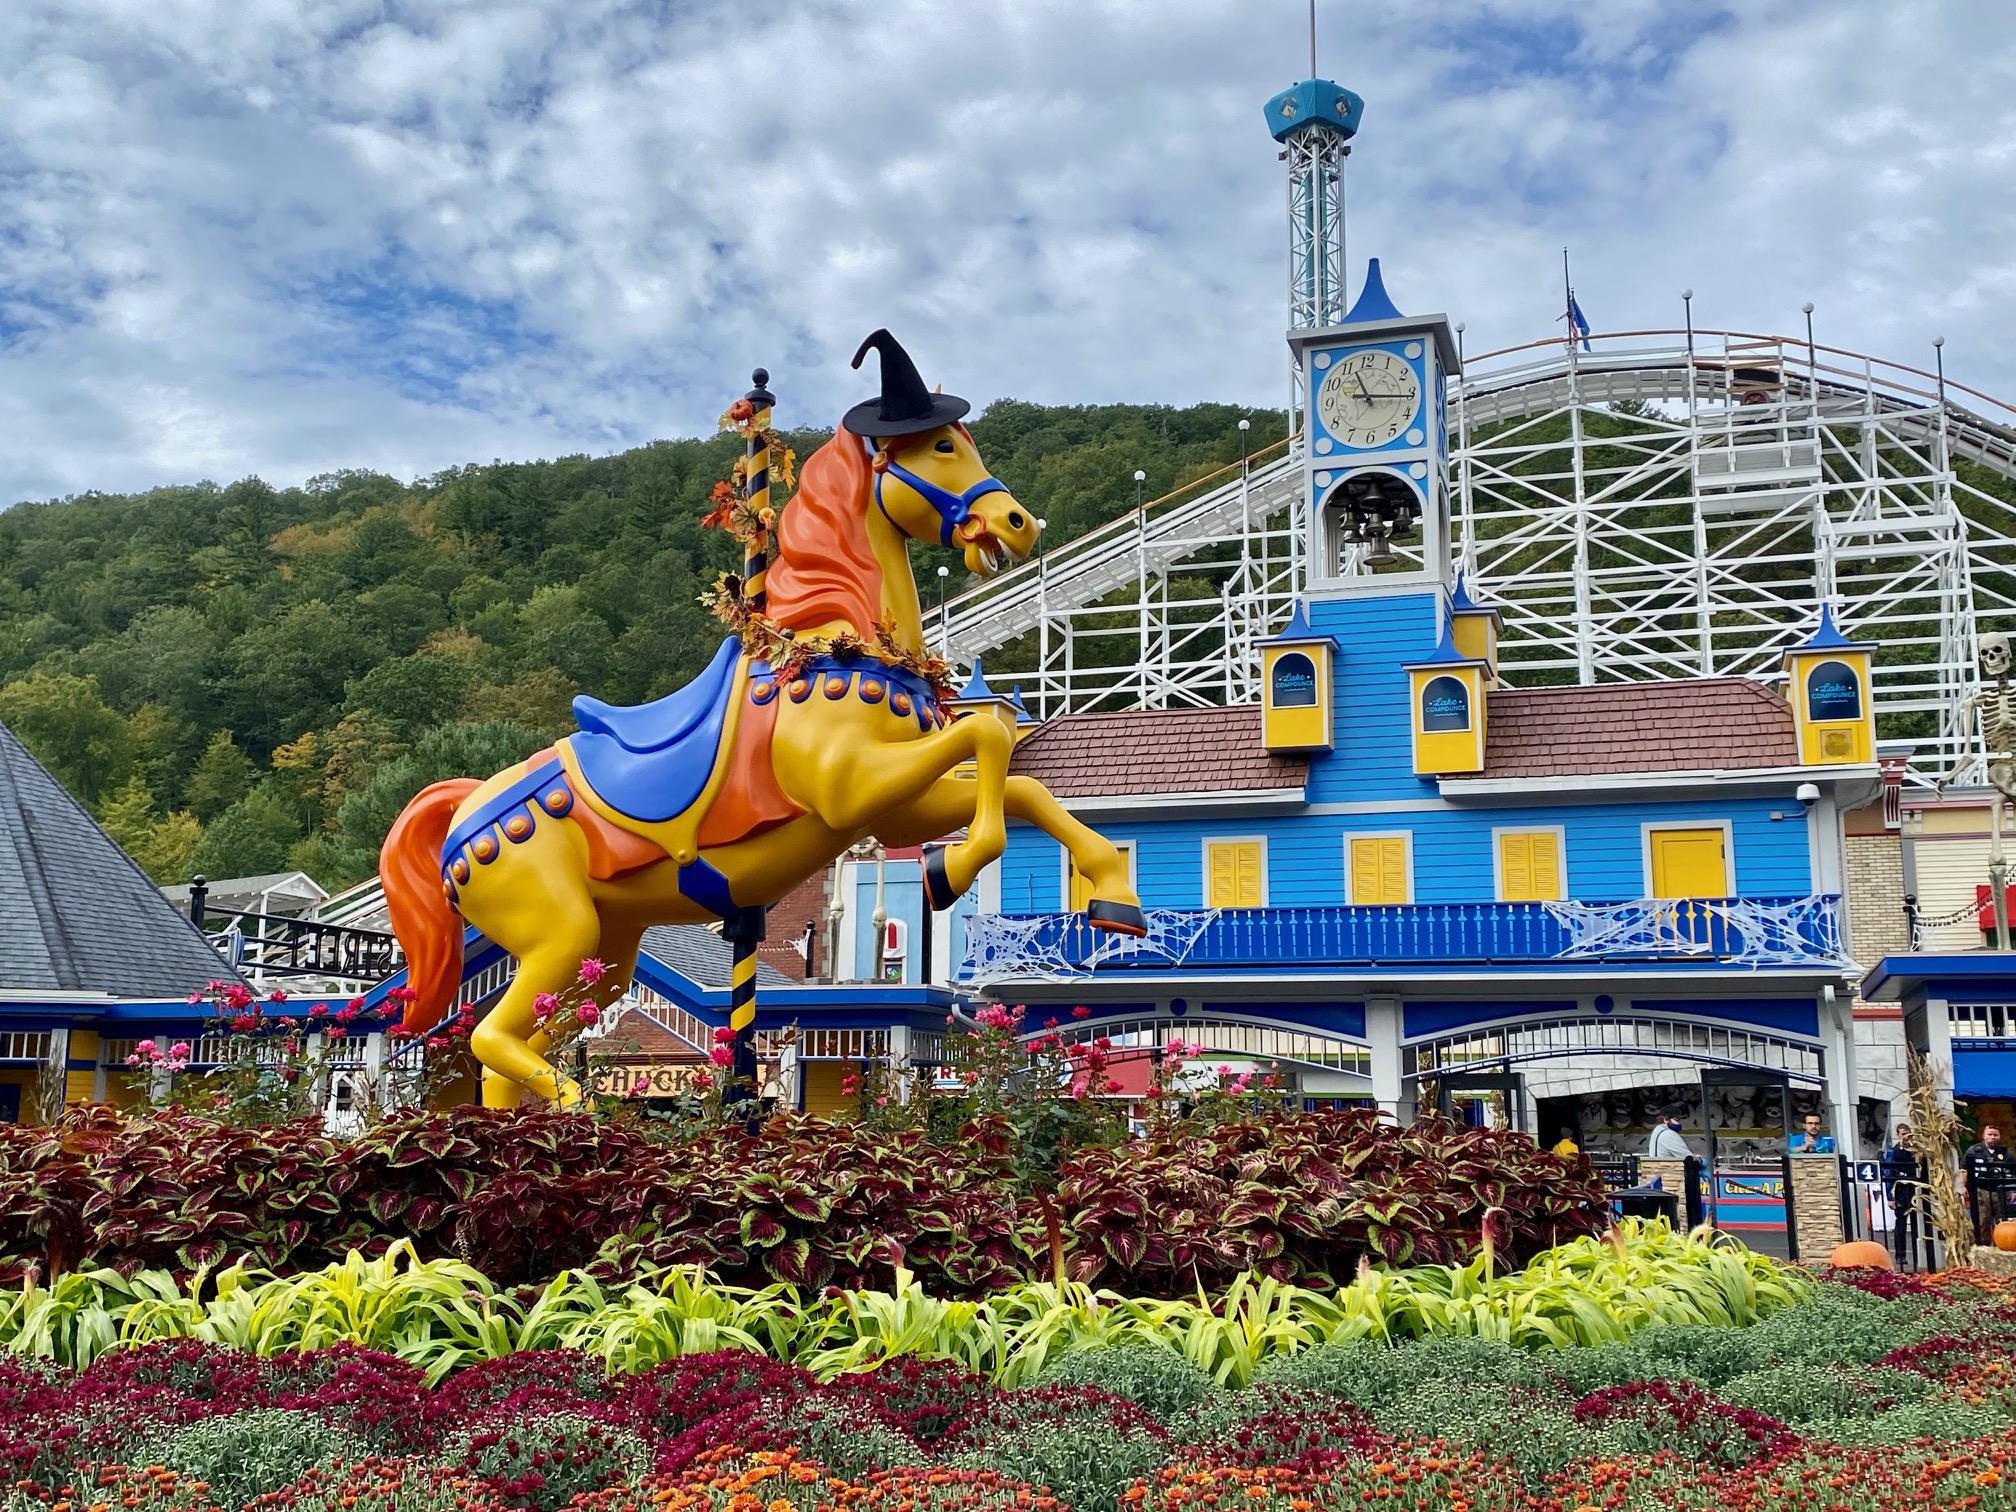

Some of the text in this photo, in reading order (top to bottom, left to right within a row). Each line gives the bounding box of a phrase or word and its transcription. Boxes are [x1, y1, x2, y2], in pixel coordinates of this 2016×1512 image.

[1360, 354, 1375, 369] 12
[1384, 356, 1391, 370] 1
[1342, 362, 1353, 376] 11
[1399, 367, 1409, 382] 2
[1325, 377, 1341, 392] 10
[1406, 386, 1416, 401] 3
[1324, 397, 1335, 412] 9
[1402, 405, 1412, 420] 4
[1330, 416, 1340, 430] 8
[1347, 428, 1356, 442] 7
[1366, 430, 1375, 444] 6
[1387, 423, 1398, 438] 5
[1281, 672, 1306, 682] Lake
[1275, 681, 1313, 689] COMPOUNCE
[1817, 682, 1848, 692] Lake
[1432, 696, 1458, 706] Lake
[1811, 691, 1857, 700] COMPOUNCE
[1425, 704, 1466, 713] COMPOUNCE
[1861, 1164, 1874, 1180] 4
